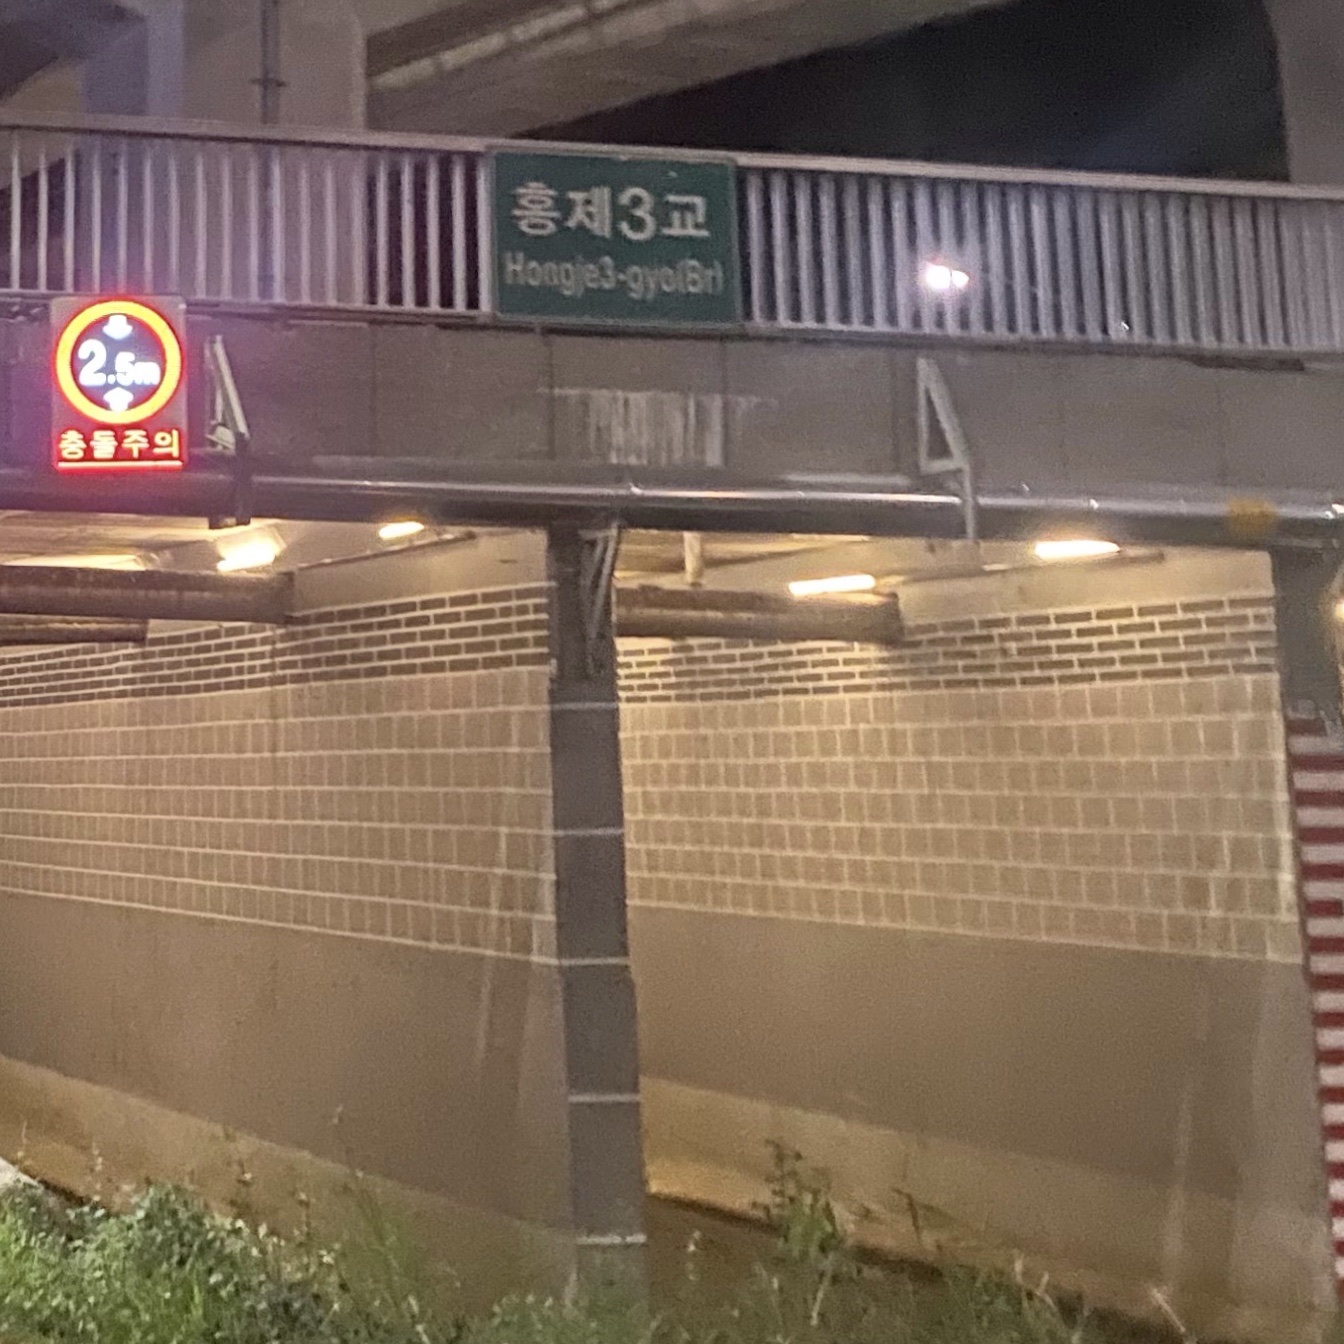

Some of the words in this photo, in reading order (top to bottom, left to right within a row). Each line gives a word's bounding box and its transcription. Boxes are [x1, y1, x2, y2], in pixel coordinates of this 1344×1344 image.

[511, 181, 710, 241] 홍제3교
[77, 338, 161, 387] 2.5m
[59, 429, 180, 460] 충돌주의
